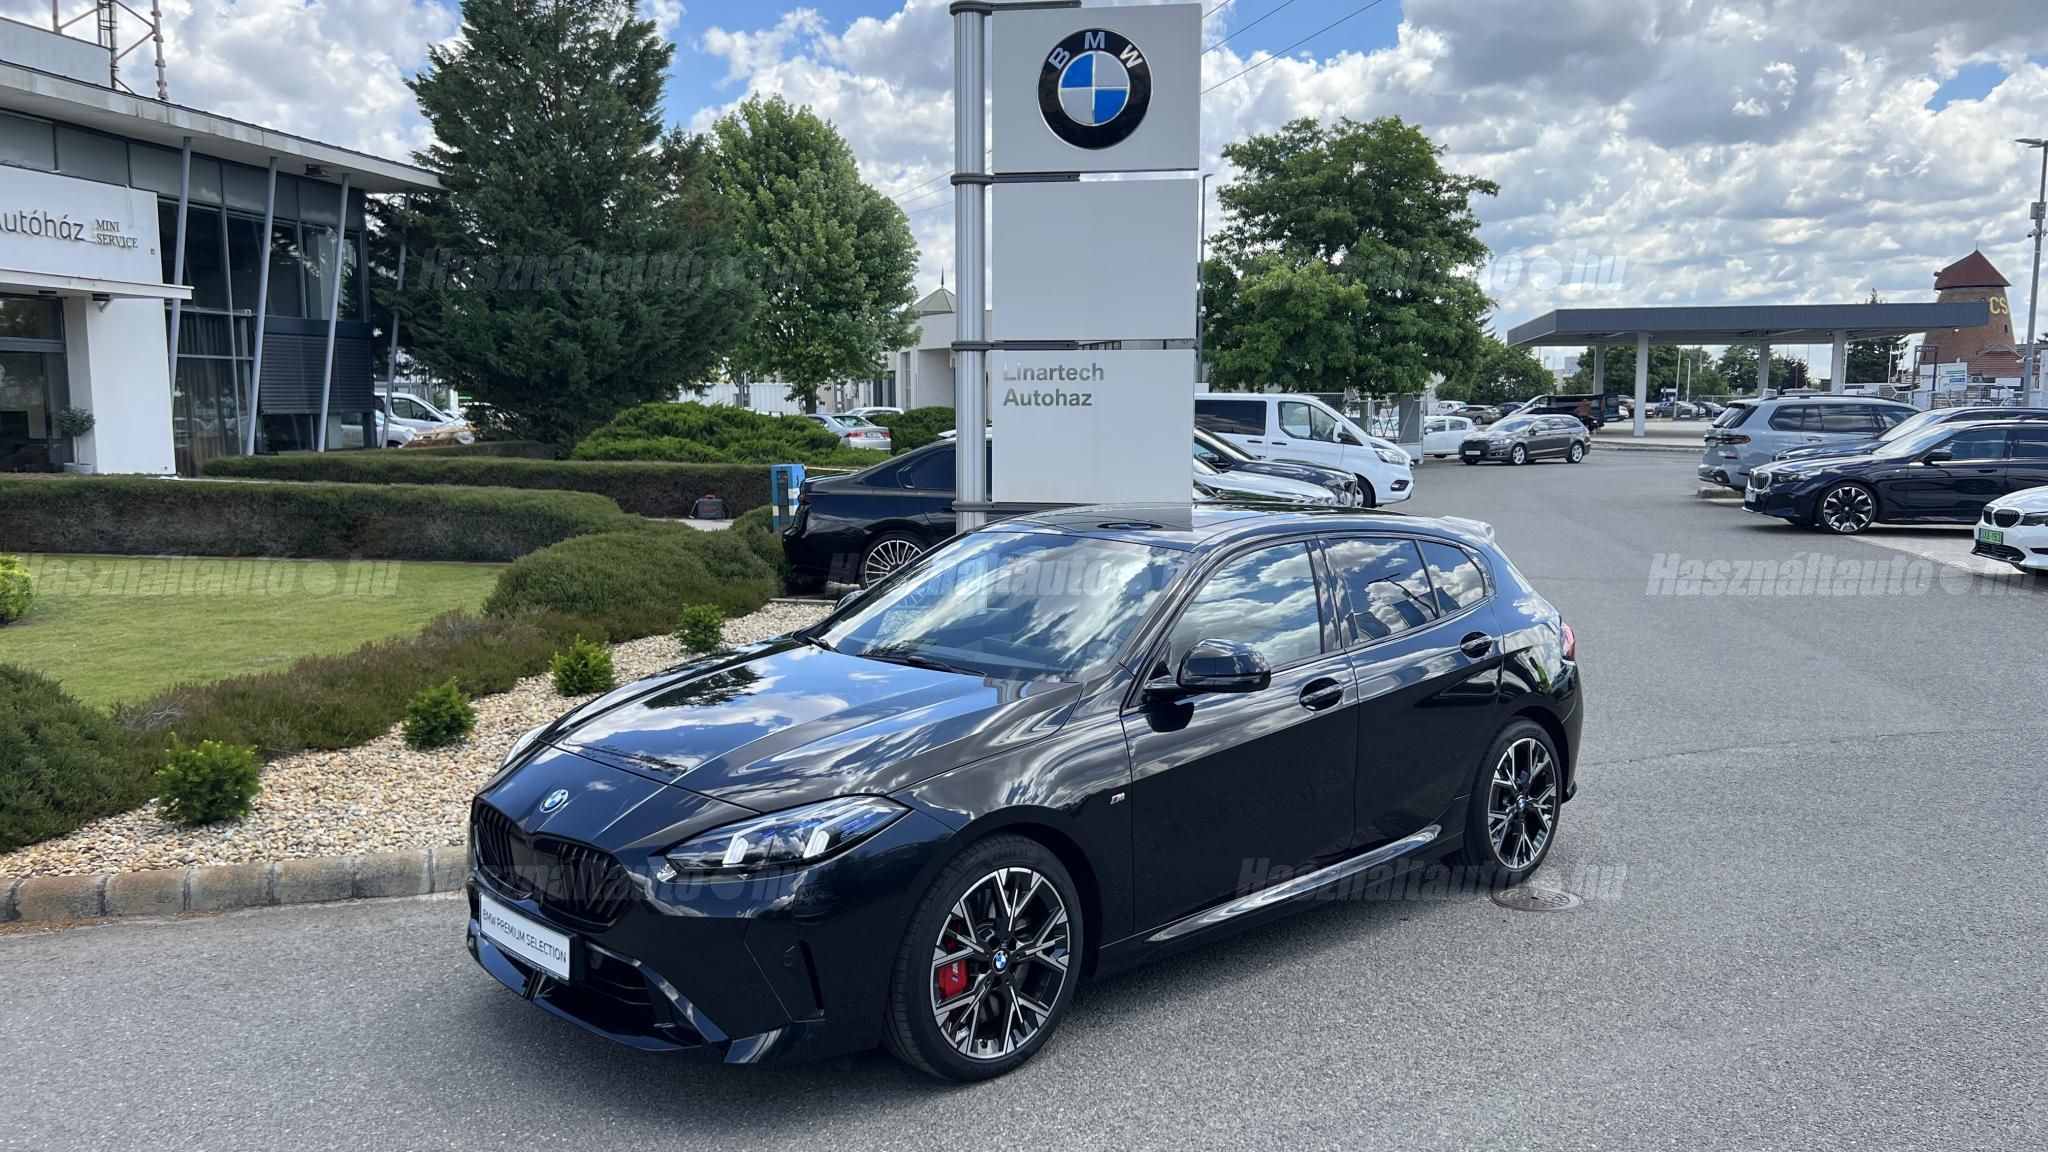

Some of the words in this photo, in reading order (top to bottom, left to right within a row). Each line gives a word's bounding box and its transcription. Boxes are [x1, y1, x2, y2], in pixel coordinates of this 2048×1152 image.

[1048, 31, 1143, 70] BMW
[0, 209, 86, 241] utóház
[95, 219, 120, 233] MINI
[96, 233, 138, 248] SERVICE
[1003, 362, 1104, 381] Linartech
[1003, 388, 1093, 406] Autohaz
[482, 908, 496, 926] BMW
[497, 917, 525, 942] PREMIUM
[526, 934, 567, 963] SELECTION
